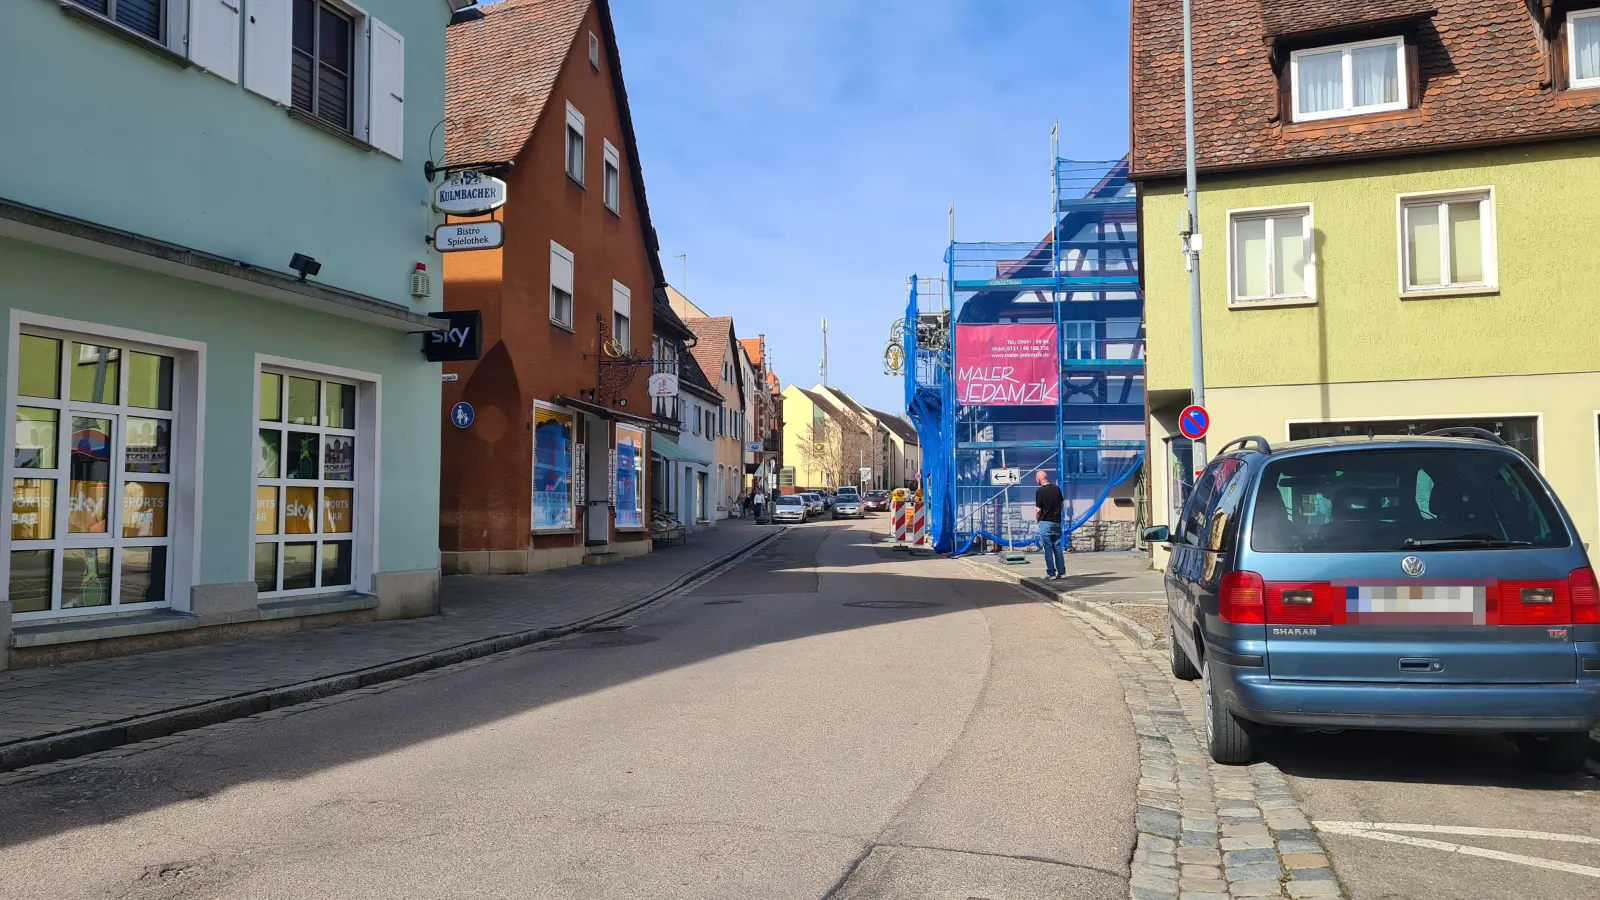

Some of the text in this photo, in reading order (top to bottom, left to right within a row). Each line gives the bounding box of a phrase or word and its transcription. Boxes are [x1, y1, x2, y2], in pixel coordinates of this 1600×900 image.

[439, 187, 497, 203] KULMBACHER
[457, 227, 480, 236] Bistro
[447, 235, 490, 248] Spielothek
[958, 365, 1020, 384] MALER
[286, 499, 313, 520] sky
[1272, 628, 1317, 636] SHARAN
